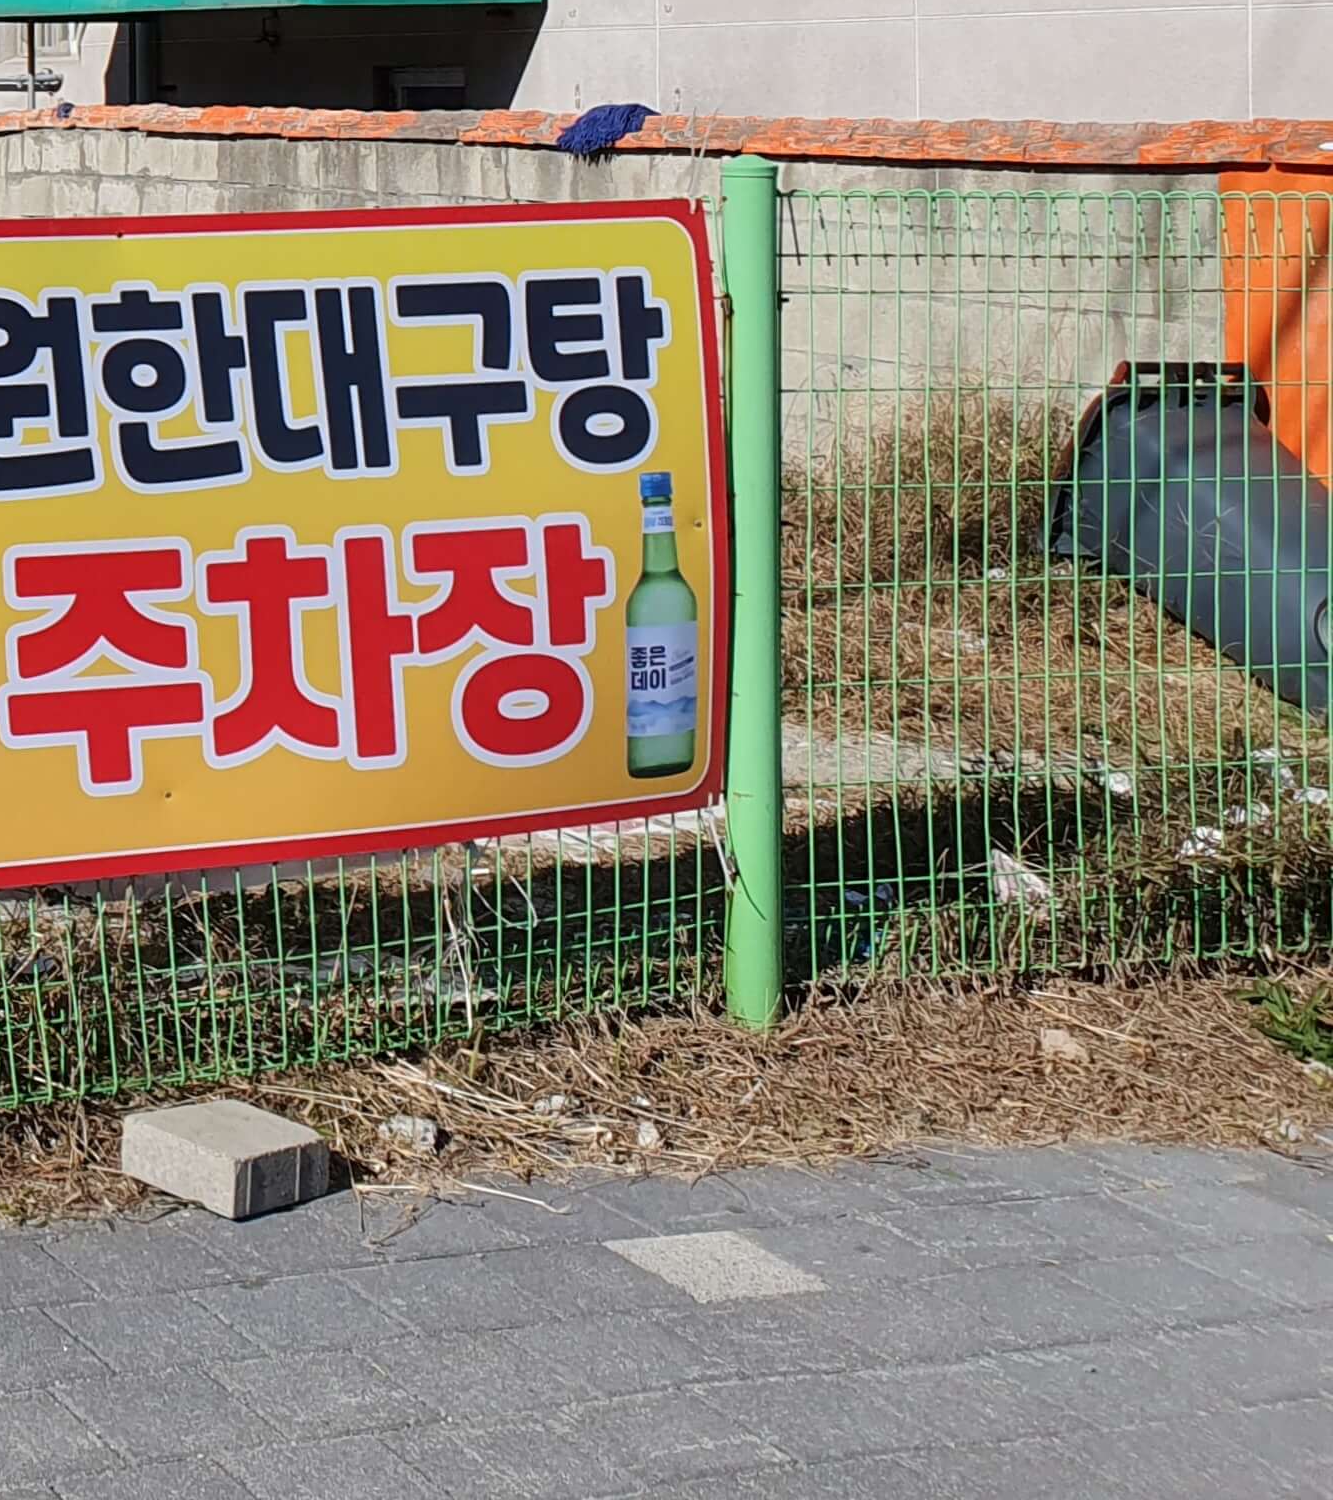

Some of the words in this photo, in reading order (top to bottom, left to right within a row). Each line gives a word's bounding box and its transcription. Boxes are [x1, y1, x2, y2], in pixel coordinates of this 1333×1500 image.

[5, 521, 607, 784] 주차장
[631, 645, 666, 668] 좋은
[631, 668, 666, 690] 데이
